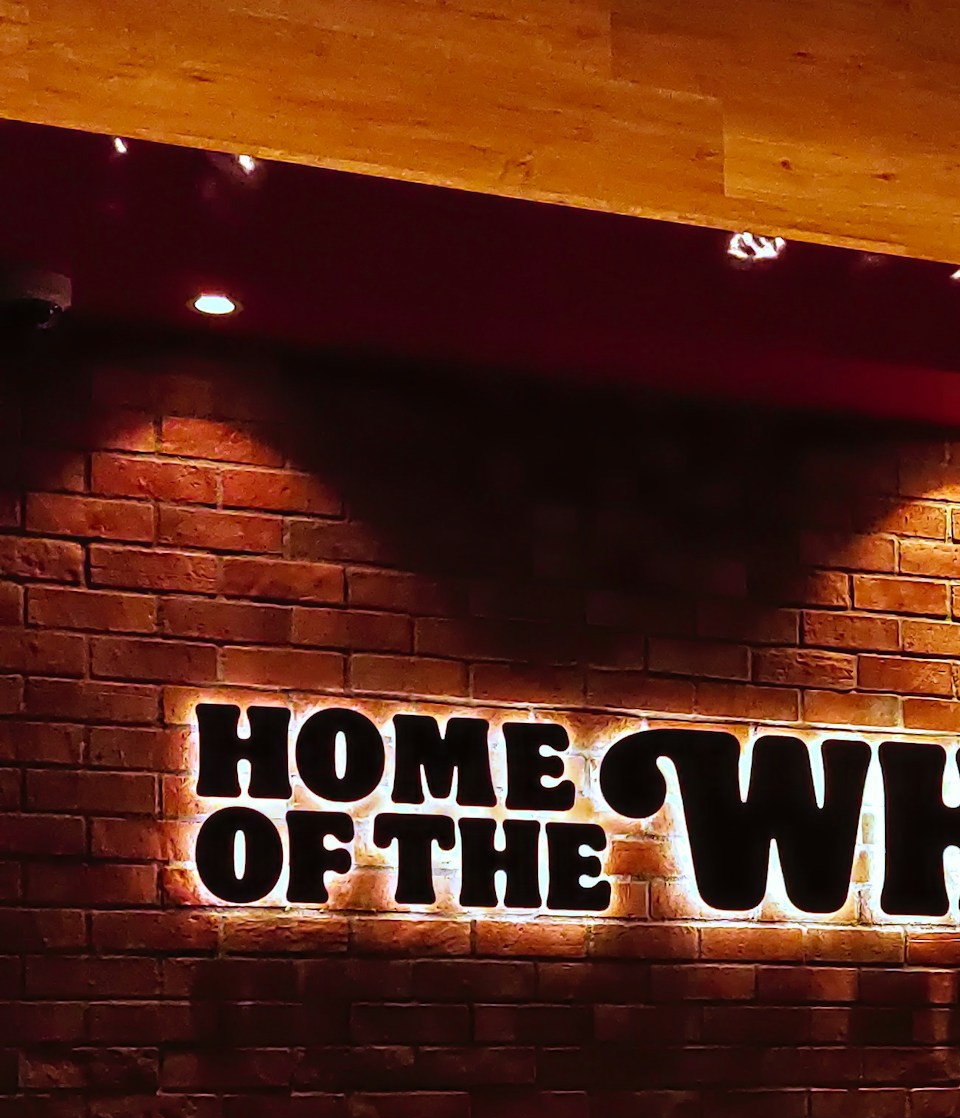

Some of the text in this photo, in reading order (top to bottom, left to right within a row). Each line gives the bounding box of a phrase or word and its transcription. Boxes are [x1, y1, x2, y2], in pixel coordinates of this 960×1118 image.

[195, 703, 576, 811] HOME
[195, 806, 612, 912] OF THE
